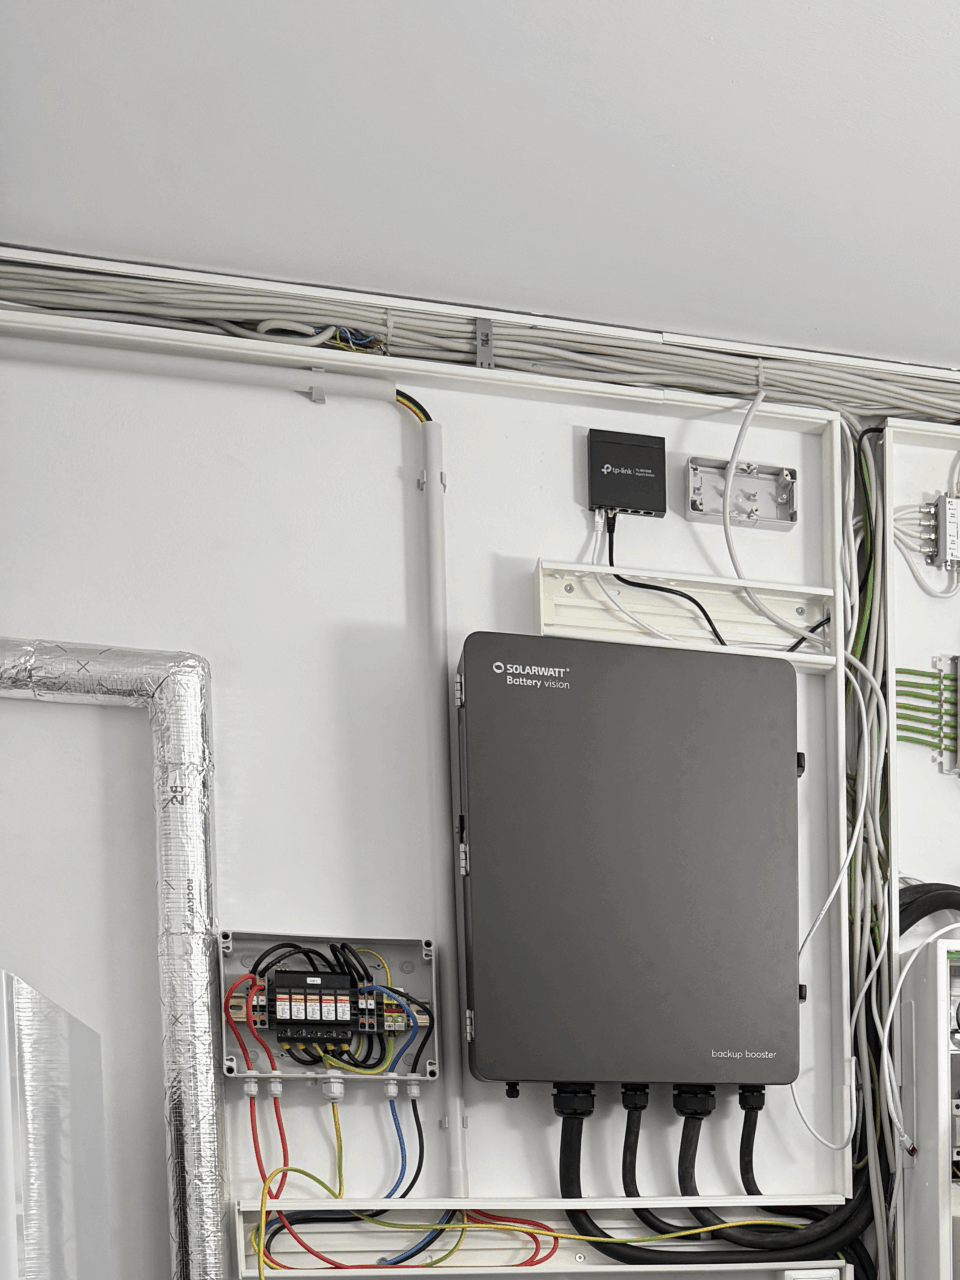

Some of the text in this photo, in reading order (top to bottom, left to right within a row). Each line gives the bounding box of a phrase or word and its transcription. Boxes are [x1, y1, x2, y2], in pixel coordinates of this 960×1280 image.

[612, 467, 633, 475] tp-link
[506, 664, 566, 678] SOLARWATT
[506, 675, 570, 689] Battery vision
[711, 1049, 777, 1060] backup booster
